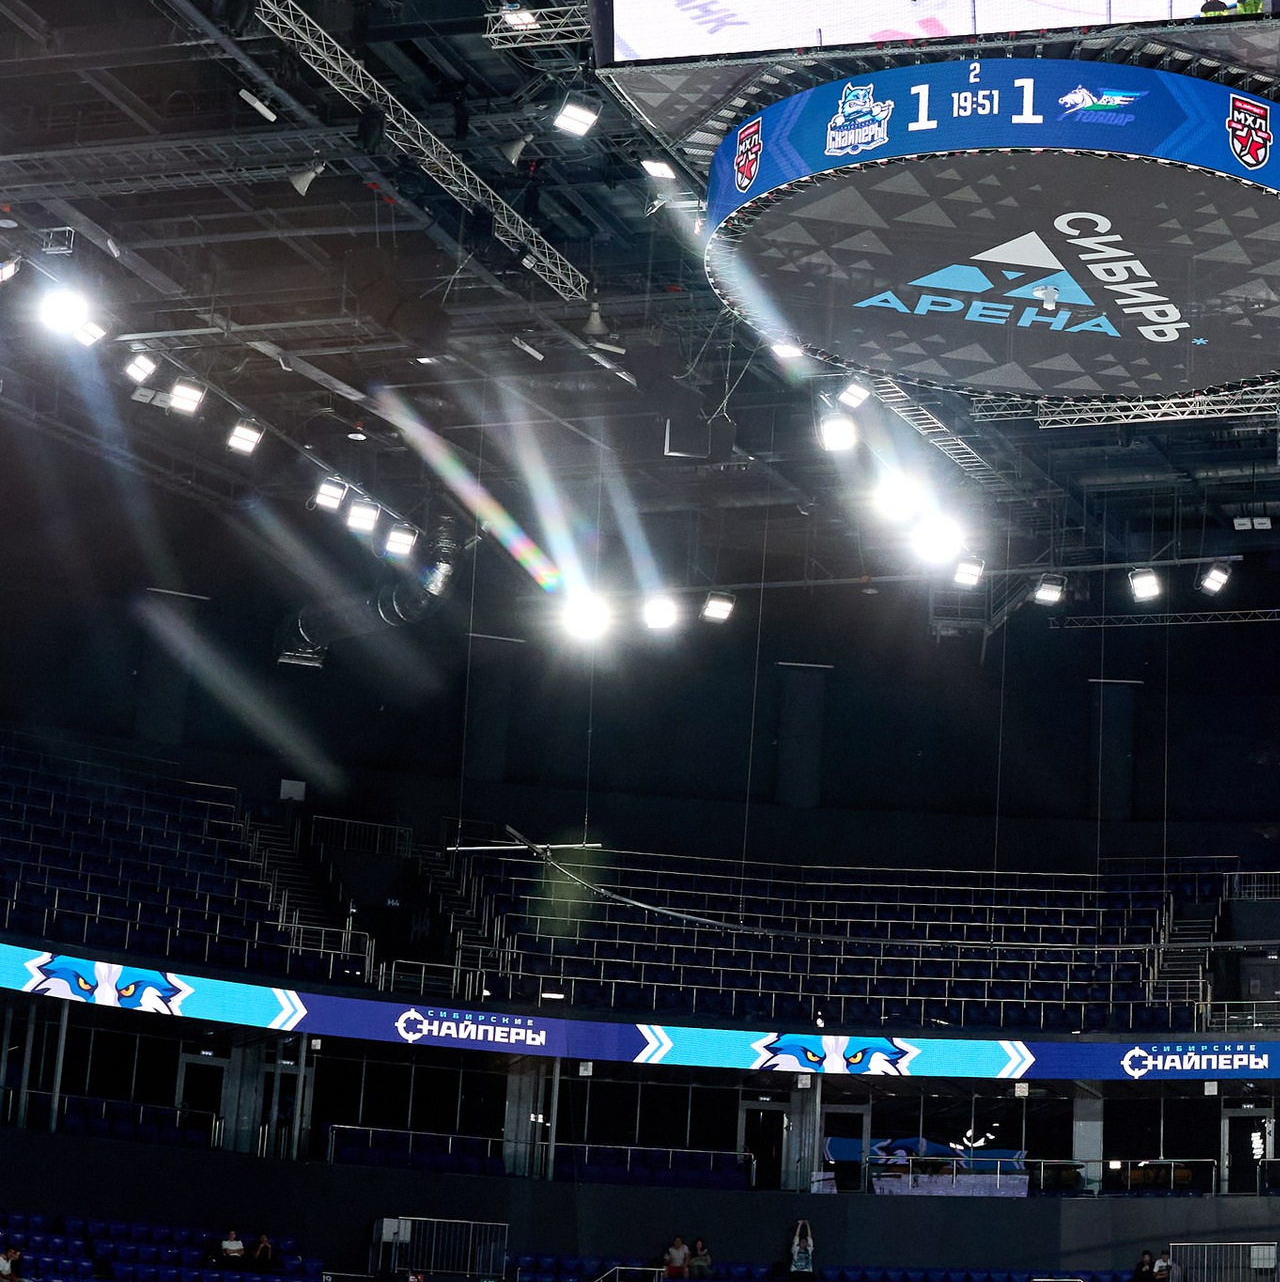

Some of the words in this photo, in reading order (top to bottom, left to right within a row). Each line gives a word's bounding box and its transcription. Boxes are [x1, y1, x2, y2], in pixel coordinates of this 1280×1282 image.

[969, 62, 980, 83] 2
[908, 84, 938, 131] 1
[952, 89, 999, 117] 19:51
[1012, 78, 1043, 124] 1
[1234, 111, 1266, 130] МХЛ
[1053, 211, 1192, 343] СИБИРЬ
[852, 290, 1122, 338] АРЕНА
[395, 1008, 546, 1045] СНАЙПЕРЫ
[428, 1010, 534, 1026] СИБИРСКИЕ
[1120, 1046, 1269, 1079] СНАЙПЕРЫ
[1151, 1044, 1256, 1052] СИБИРСКИЕ
